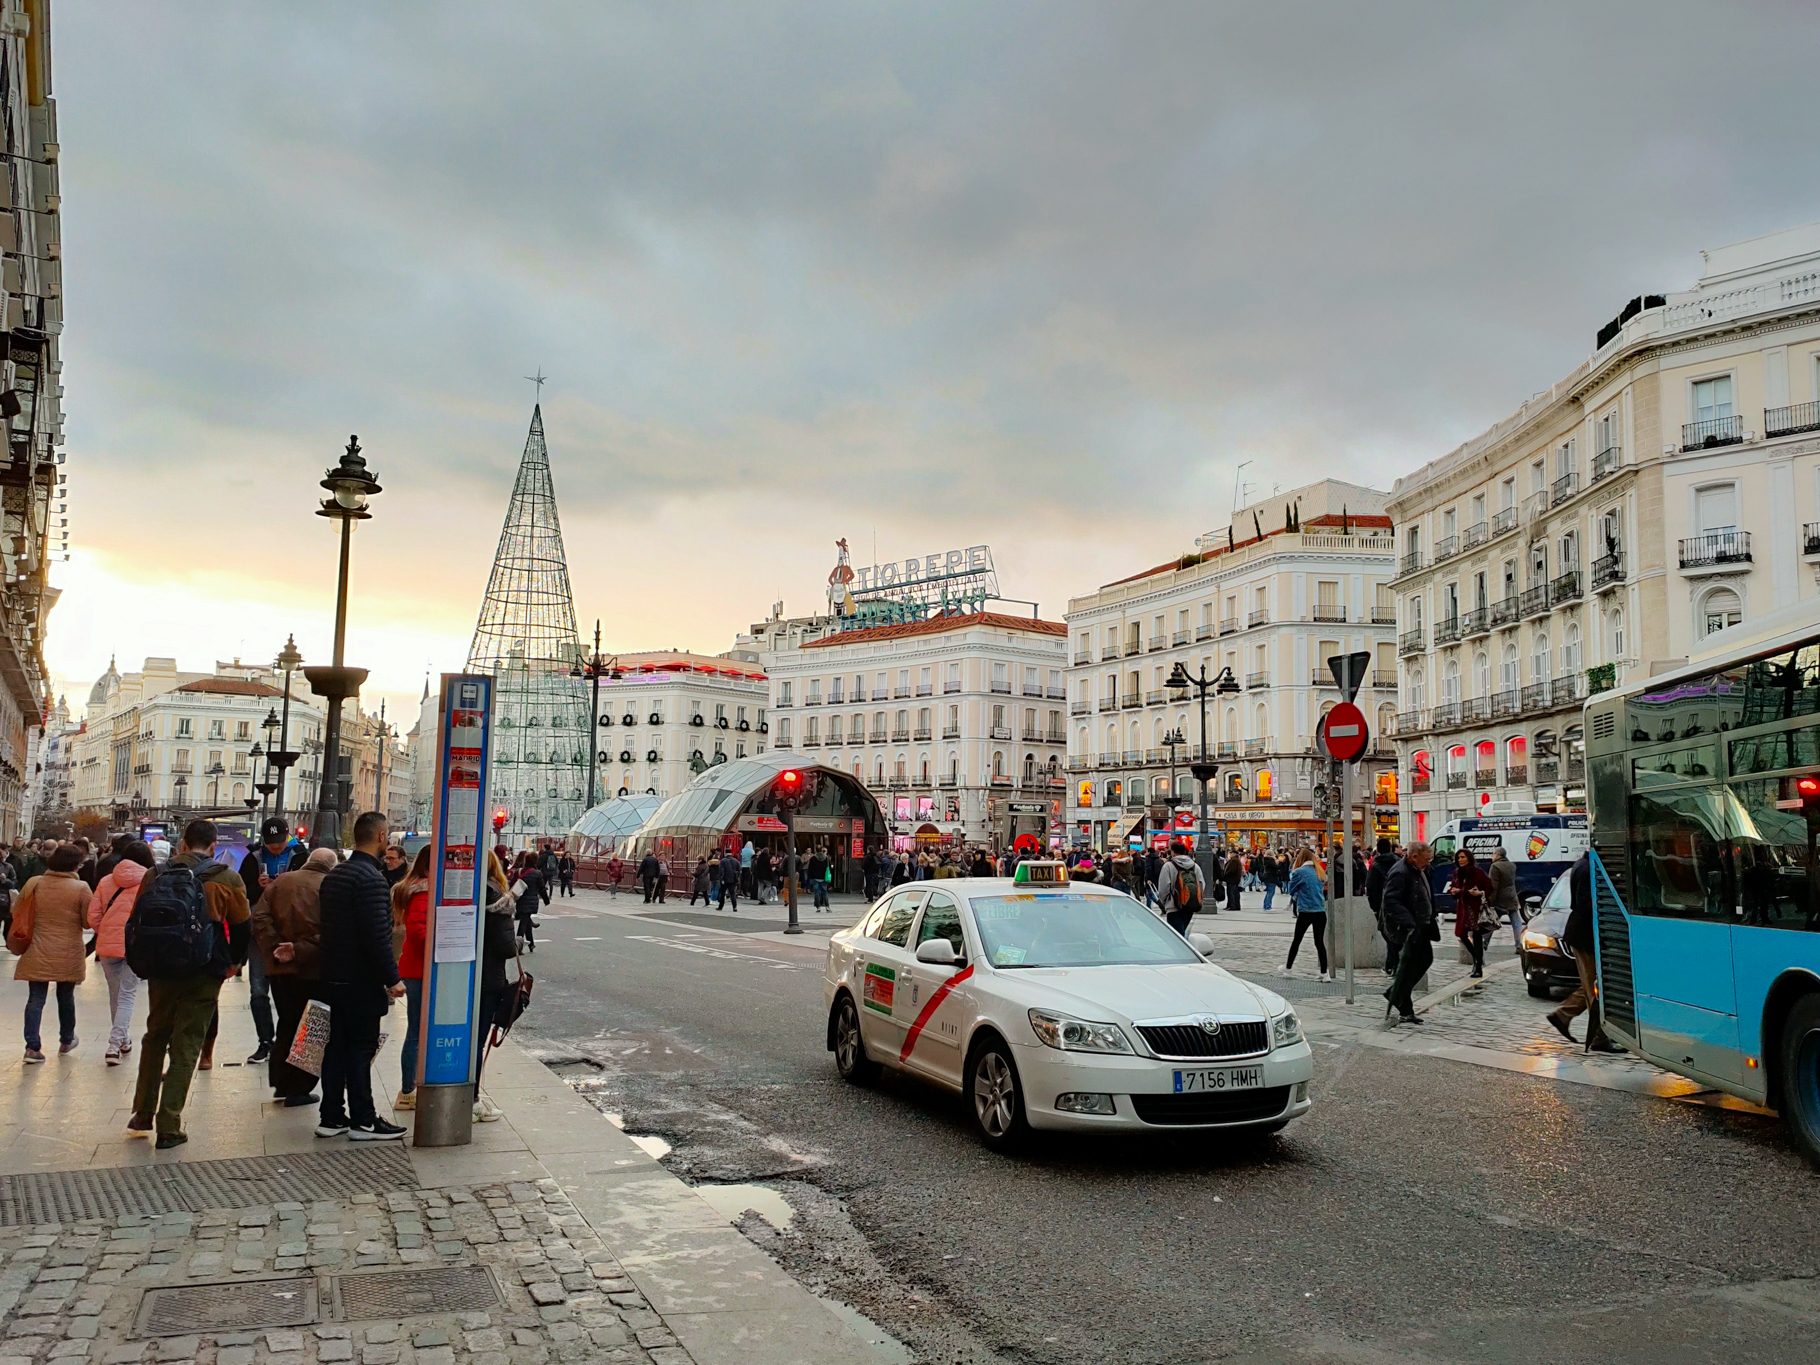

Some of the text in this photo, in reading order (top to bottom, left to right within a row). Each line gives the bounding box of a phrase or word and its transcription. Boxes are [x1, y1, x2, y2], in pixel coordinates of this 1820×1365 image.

[857, 545, 987, 589] TIO PEPE
[1223, 811, 1238, 819] CASA
[1466, 837, 1500, 847] OFICINA
[1031, 866, 1054, 881] TAXI
[988, 903, 1019, 919] LIBRE
[436, 1037, 463, 1048] EMT
[1186, 1069, 1258, 1090] 7156 HMH
